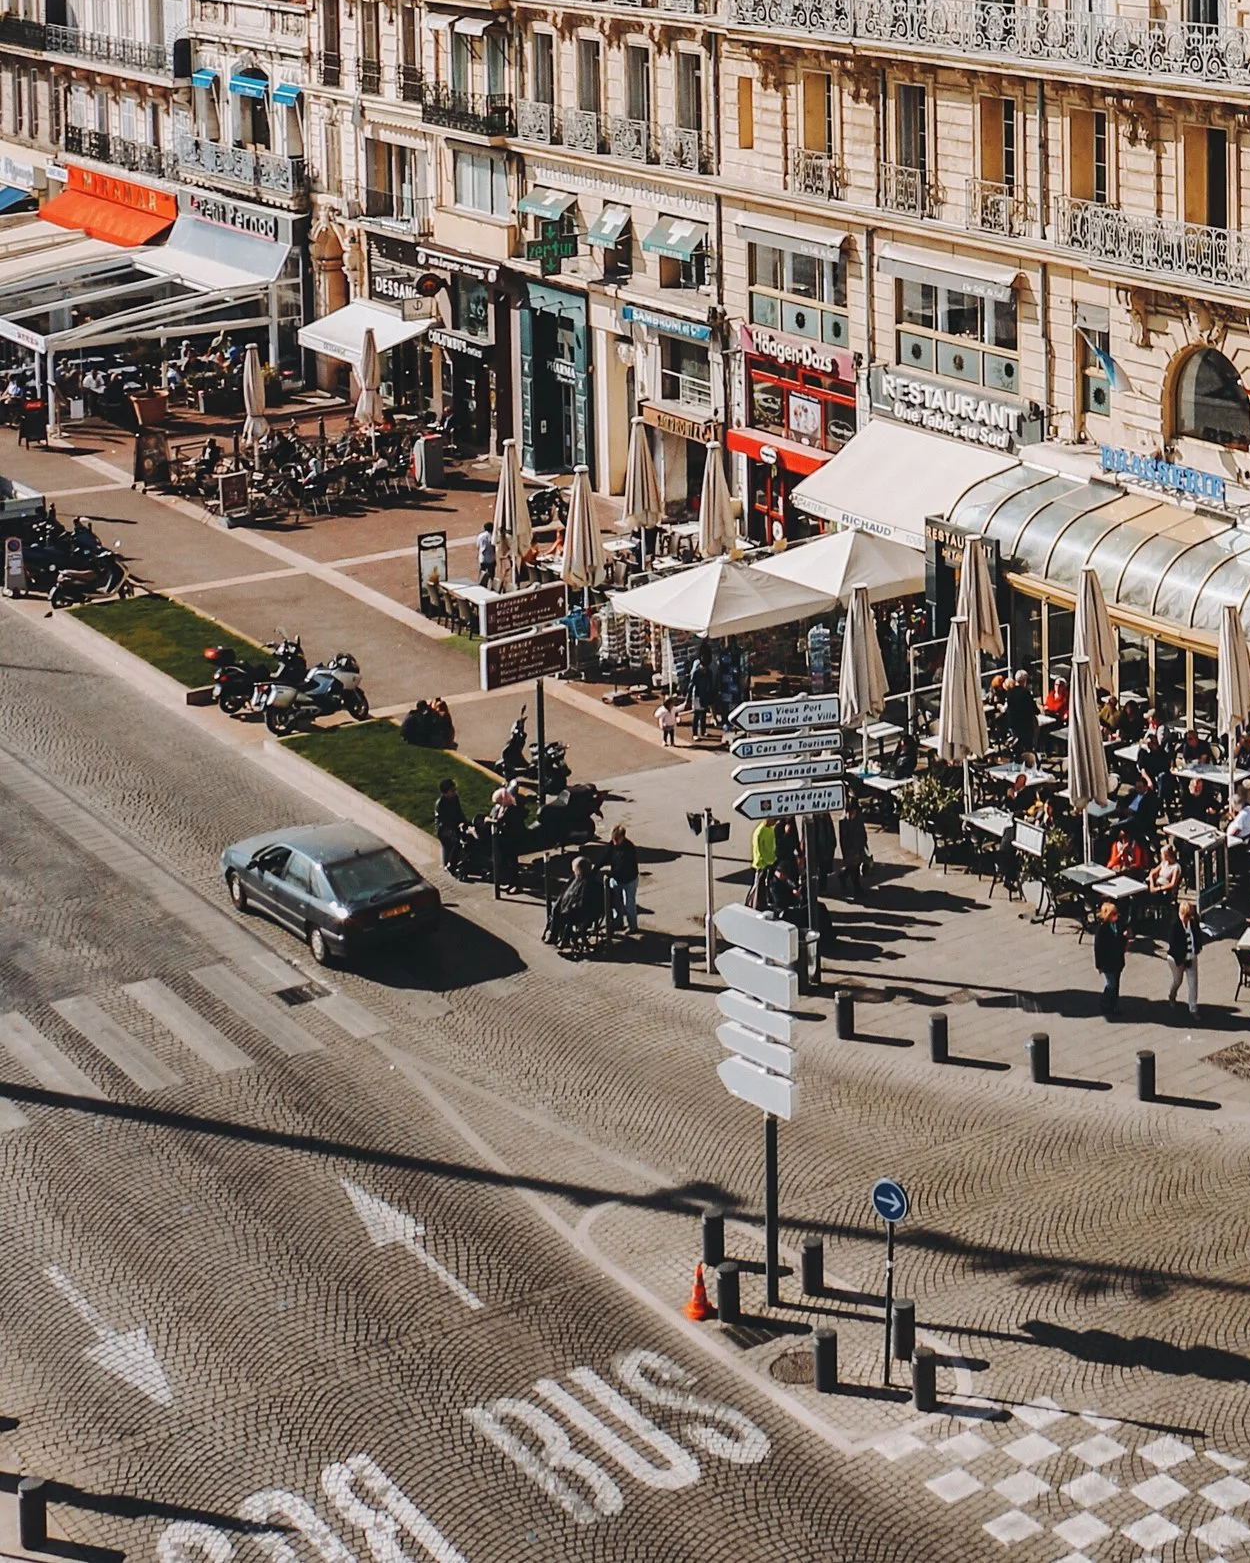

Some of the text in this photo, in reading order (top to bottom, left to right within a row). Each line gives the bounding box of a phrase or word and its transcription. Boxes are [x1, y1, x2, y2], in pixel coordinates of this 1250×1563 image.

[82, 170, 158, 211] MIRAMAR
[200, 198, 226, 223] Petit
[228, 204, 278, 238] Pernod
[375, 276, 421, 299] DESSANG
[632, 309, 681, 331] SAMBRONI
[881, 374, 1021, 432] RESTAURANT
[894, 402, 1010, 449] Une Table, au Sud
[1101, 445, 1225, 500] BRASSERIE
[841, 512, 892, 537] RICHAUD
[926, 525, 992, 558] RESTAUT
[775, 712, 836, 725] Hôtel de Ville
[776, 705, 799, 715] Vieux
[803, 704, 822, 712] Port
[756, 745, 777, 753] Cars
[799, 739, 838, 749] Tourisme
[766, 766, 817, 779] Esplanade
[777, 790, 832, 803] Cathédrale
[778, 799, 840, 813] de la Major
[464, 1349, 772, 1525] BUS
